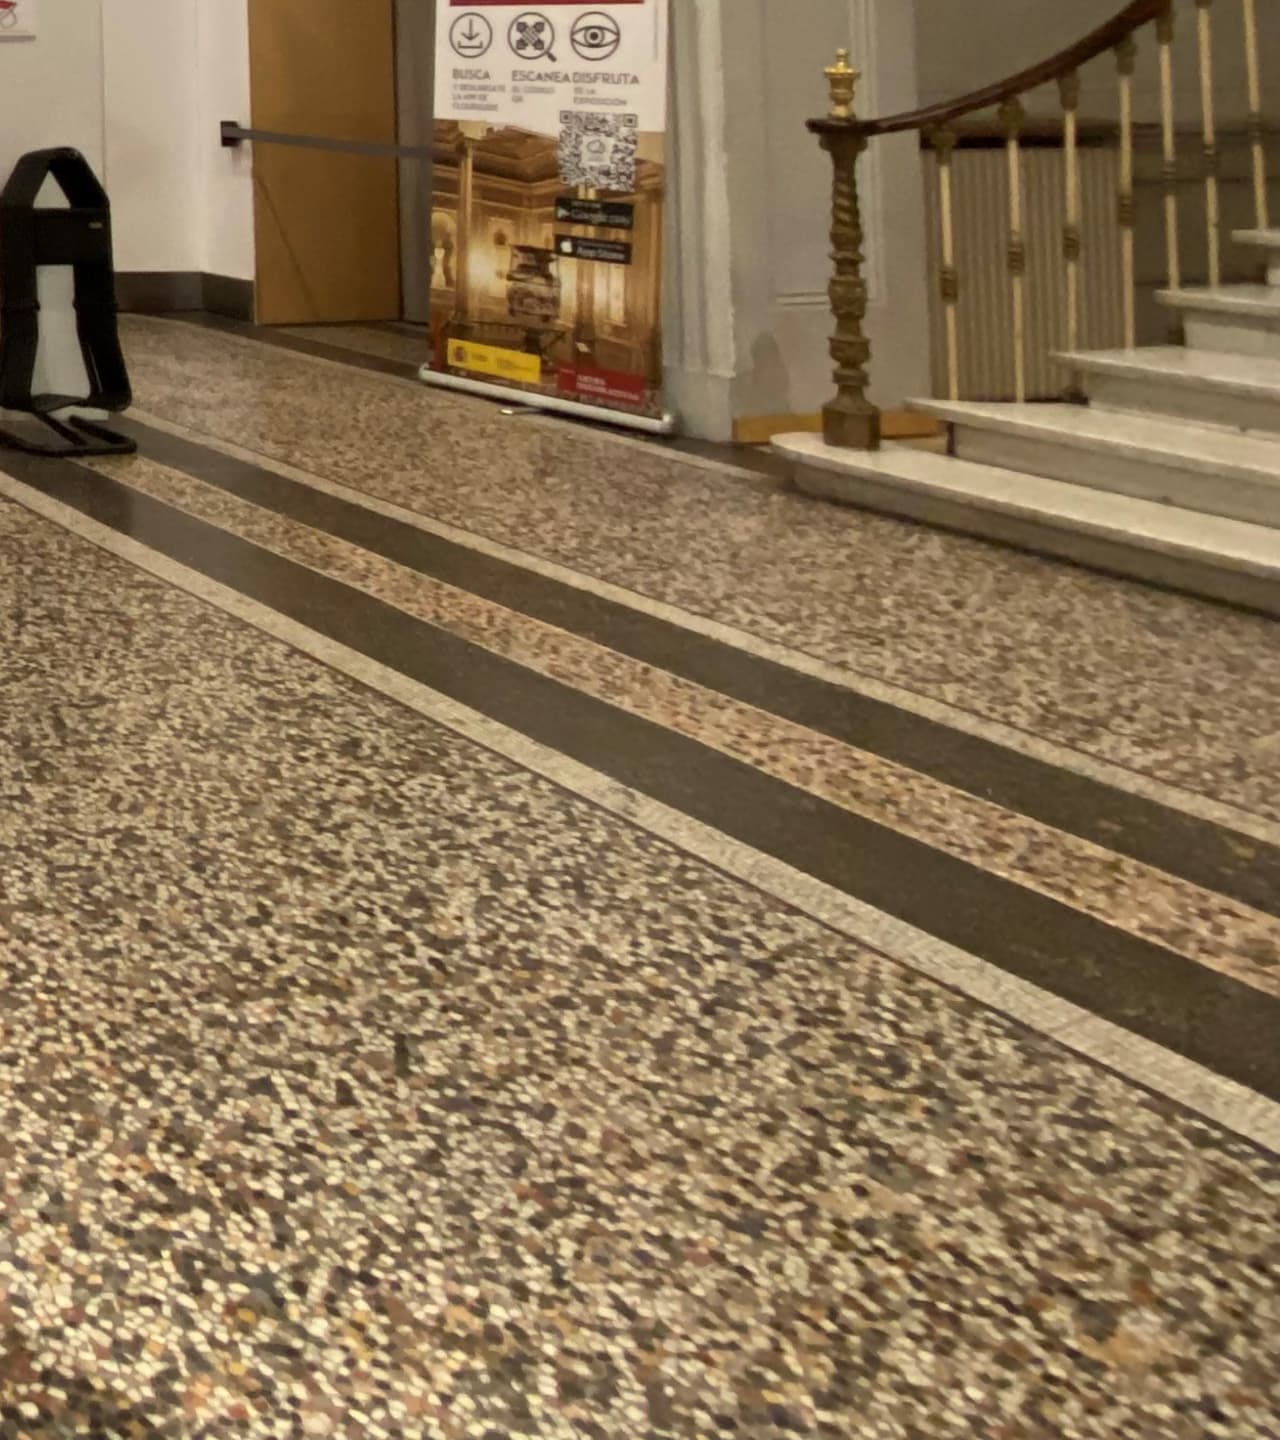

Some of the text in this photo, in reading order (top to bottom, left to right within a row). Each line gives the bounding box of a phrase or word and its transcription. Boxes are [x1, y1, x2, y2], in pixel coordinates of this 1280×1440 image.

[452, 68, 491, 81] BUSCA
[511, 70, 570, 83] ESCANEA
[572, 72, 640, 85] DISFRUTA
